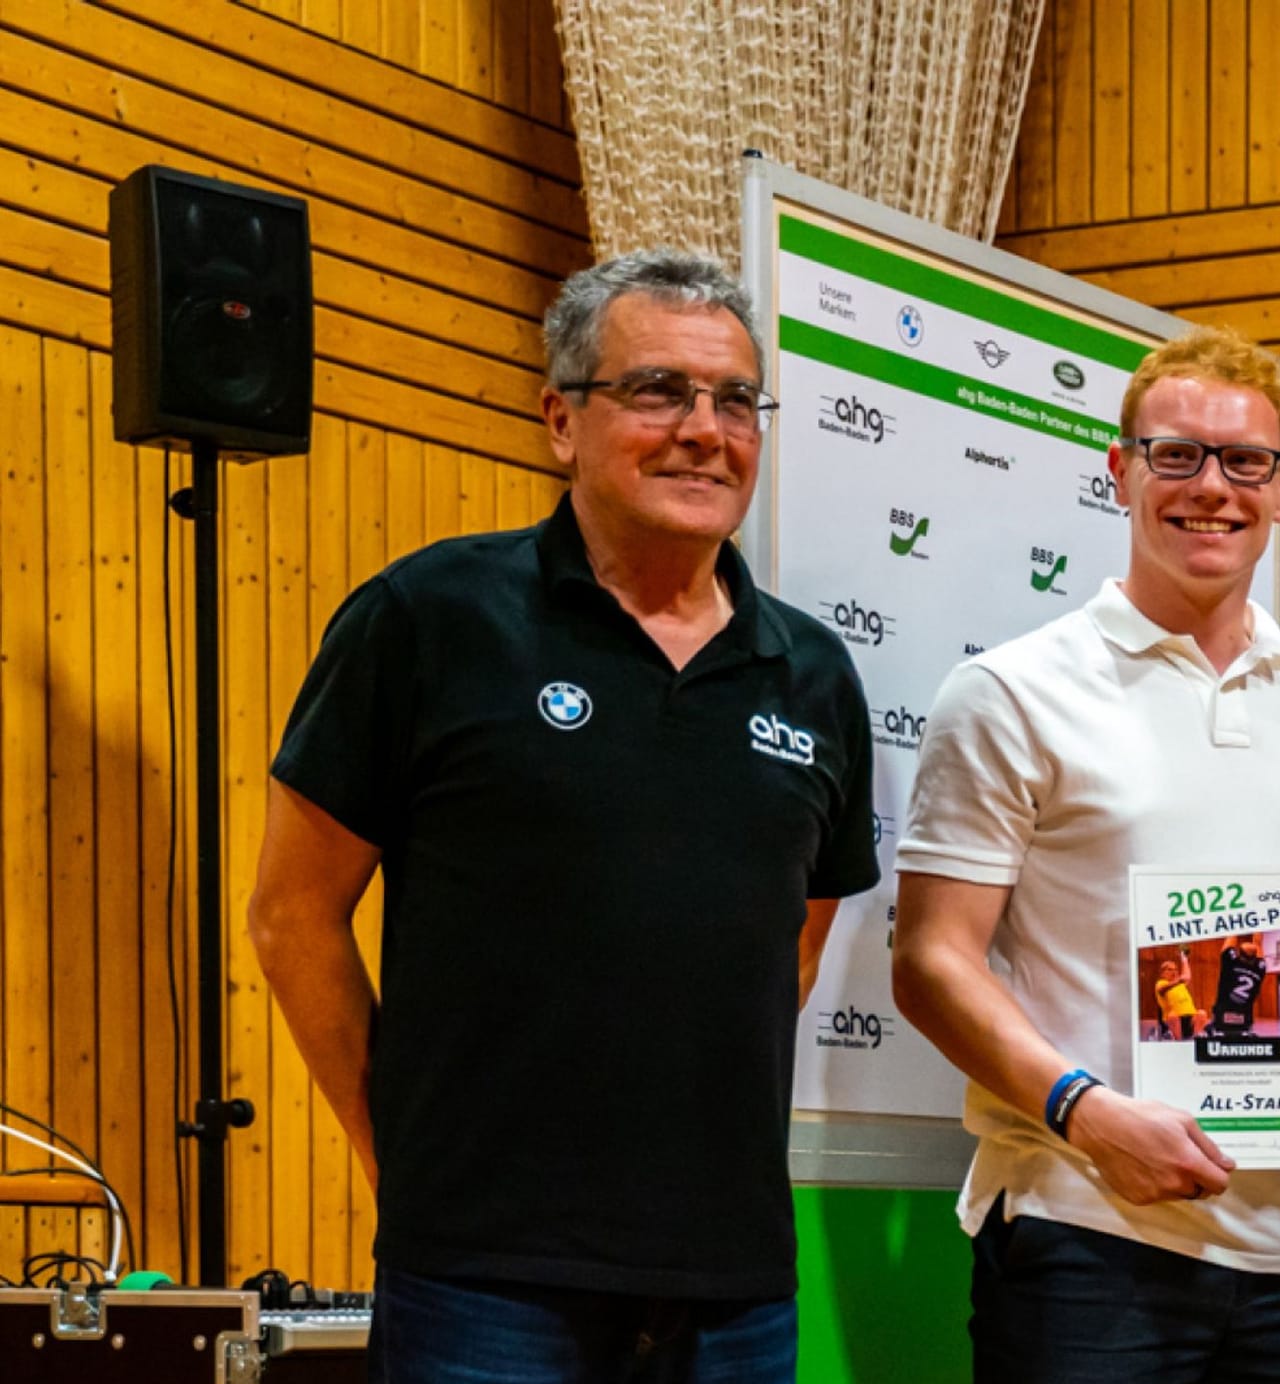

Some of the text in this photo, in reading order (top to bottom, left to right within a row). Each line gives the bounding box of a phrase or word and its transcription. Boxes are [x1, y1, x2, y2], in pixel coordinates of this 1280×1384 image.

[820, 282, 852, 305] Unsere
[834, 396, 885, 444] ahg
[977, 391, 1039, 423] Baden-Baden
[1040, 407, 1072, 433] Partner
[818, 417, 871, 443] Baden-Baden
[890, 508, 915, 529] BBS
[1030, 546, 1056, 566] BBS
[834, 599, 884, 647] ahg
[1166, 883, 1246, 918] 2022
[1146, 925, 1164, 942] 1.
[1169, 919, 1208, 939] INT.
[833, 1005, 882, 1049] ahg
[816, 1034, 869, 1049] Baden-Baden
